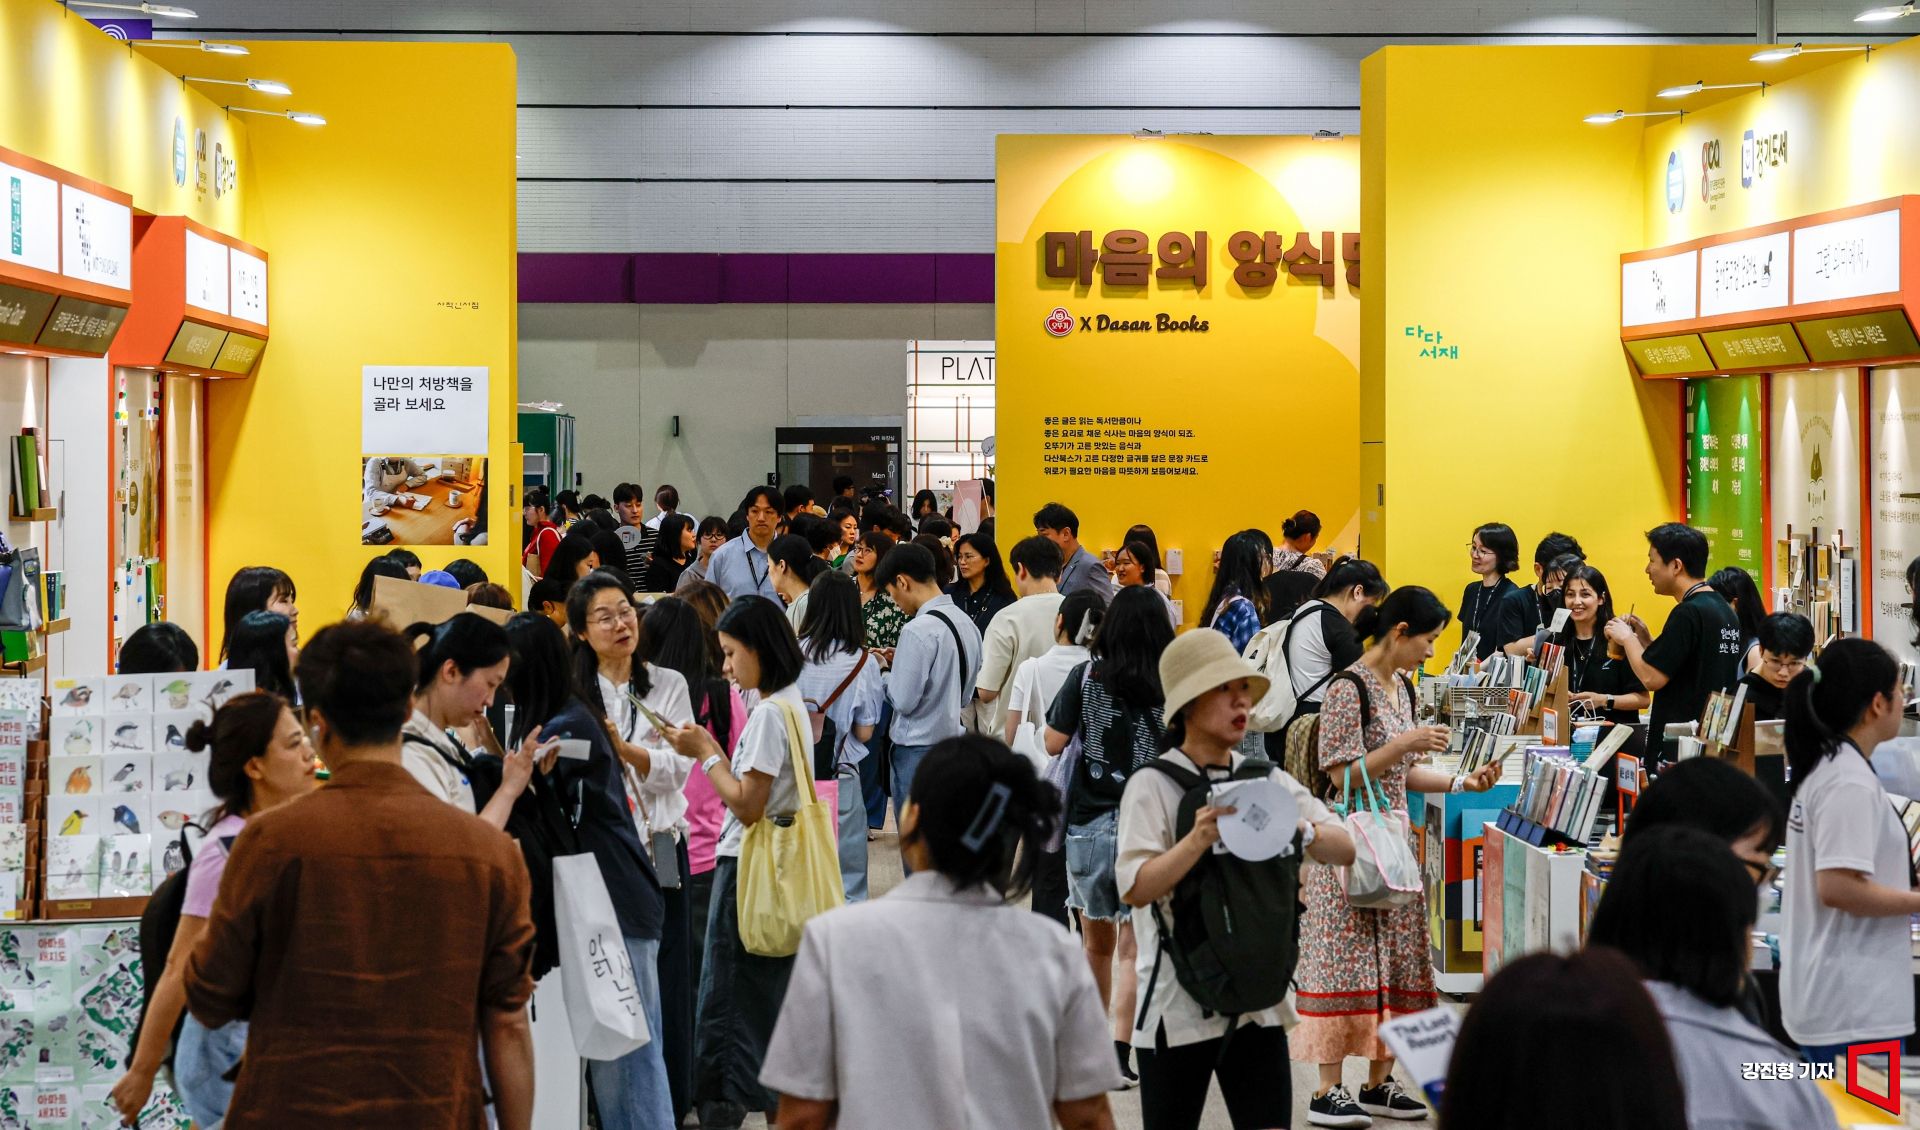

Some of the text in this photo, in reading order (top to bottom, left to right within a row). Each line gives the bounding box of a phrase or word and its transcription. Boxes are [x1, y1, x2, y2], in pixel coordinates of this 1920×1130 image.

[1044, 229, 1208, 287] 마음의
[1051, 322, 1069, 330] 오뚜기
[1080, 312, 1209, 333] X Dasan Books
[1405, 325, 1443, 344] 다다
[1419, 345, 1458, 359] 서재
[373, 376, 473, 391] 나만의 처방책을
[373, 397, 446, 412] 골라 보세요
[1044, 416, 1059, 426] 좋은
[1078, 416, 1094, 426] 읽는
[1095, 416, 1141, 426] 독서만큼이나
[1044, 429, 1059, 438] 좋은
[1061, 429, 1084, 438] 요리로
[1086, 429, 1101, 438] 채운
[1103, 429, 1126, 438] 식사는
[1128, 429, 1151, 438] 마음의
[1153, 429, 1175, 438] 양식이
[1044, 441, 1141, 451] 오뚜기가 고른 맛있는 음식과
[1044, 454, 1208, 463] 다산북스가 고른 다정한 글귀를 닮은 문장 카드로
[1044, 466, 1198, 476] 위로가 필요한 마음을 따뜻하게 보듬어보세요.
[1391, 1024, 1419, 1038] The
